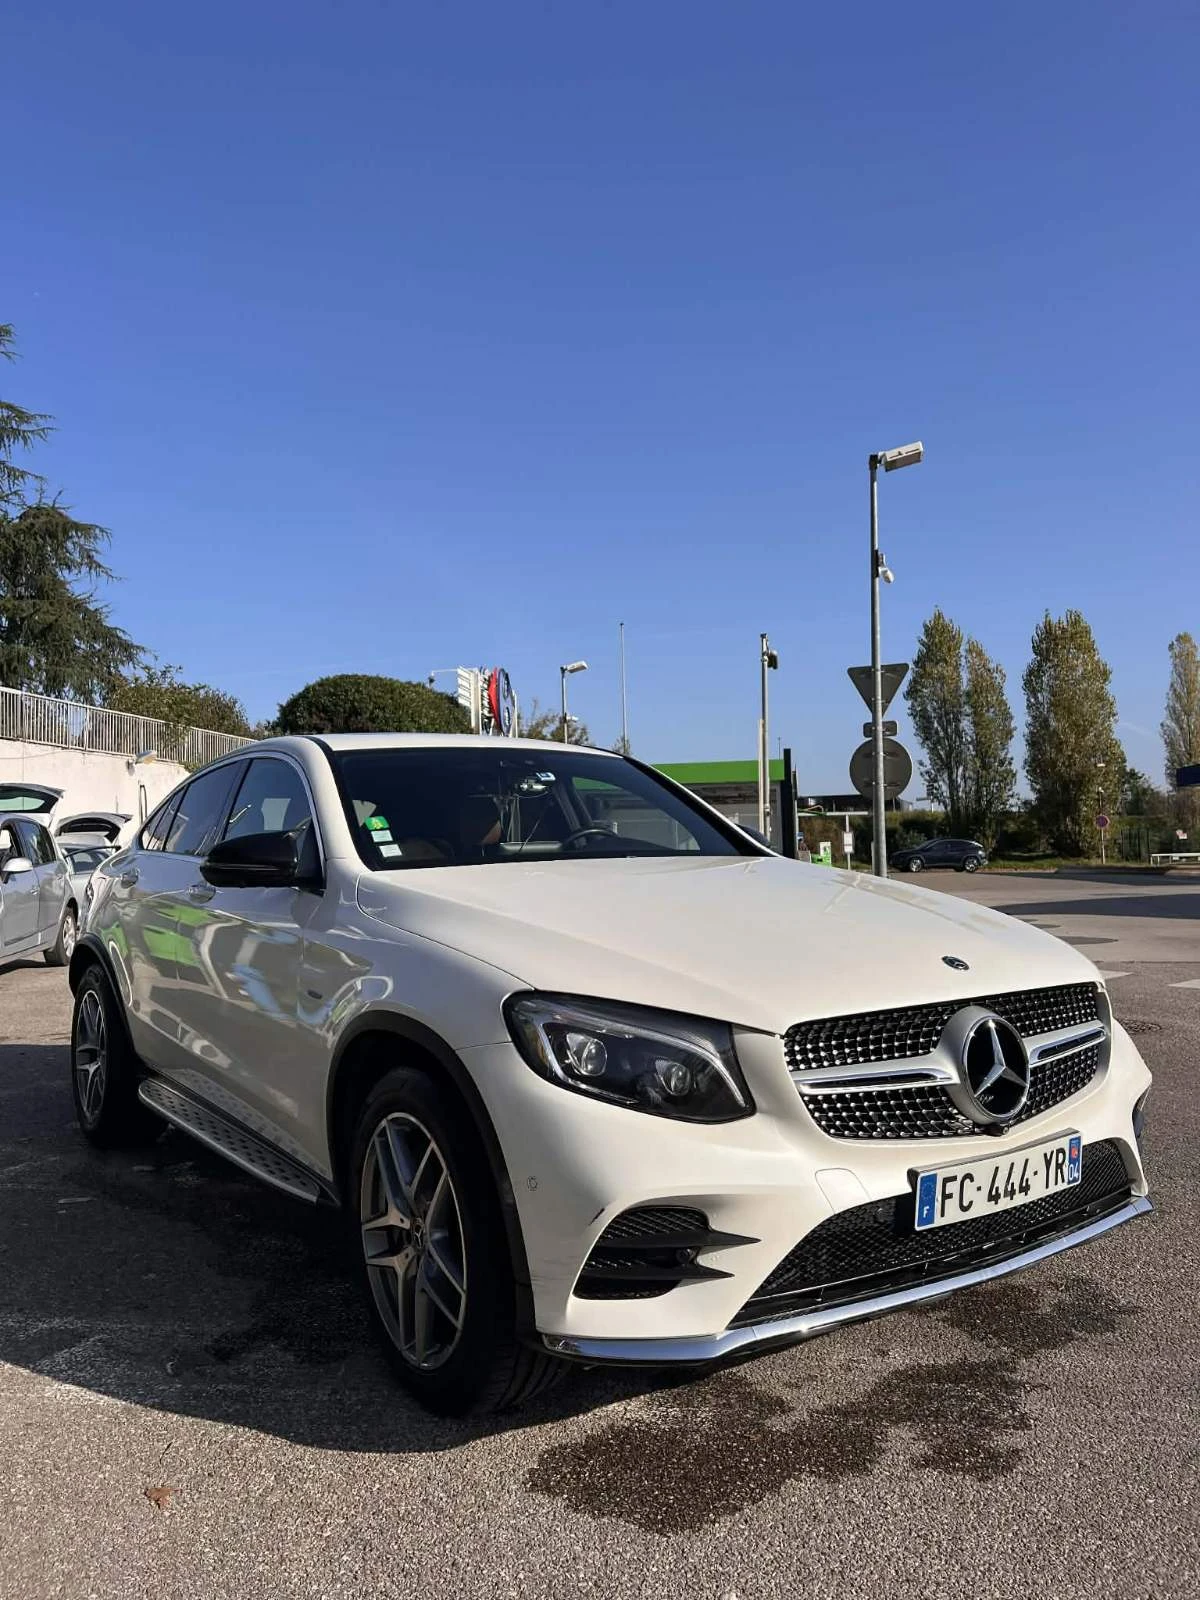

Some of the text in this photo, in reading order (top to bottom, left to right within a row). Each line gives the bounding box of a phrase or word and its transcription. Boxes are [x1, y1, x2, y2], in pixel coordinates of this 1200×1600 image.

[1068, 1162, 1079, 1180] 04
[940, 1147, 1067, 1218] FC-444-YR
[923, 1206, 929, 1218] F
